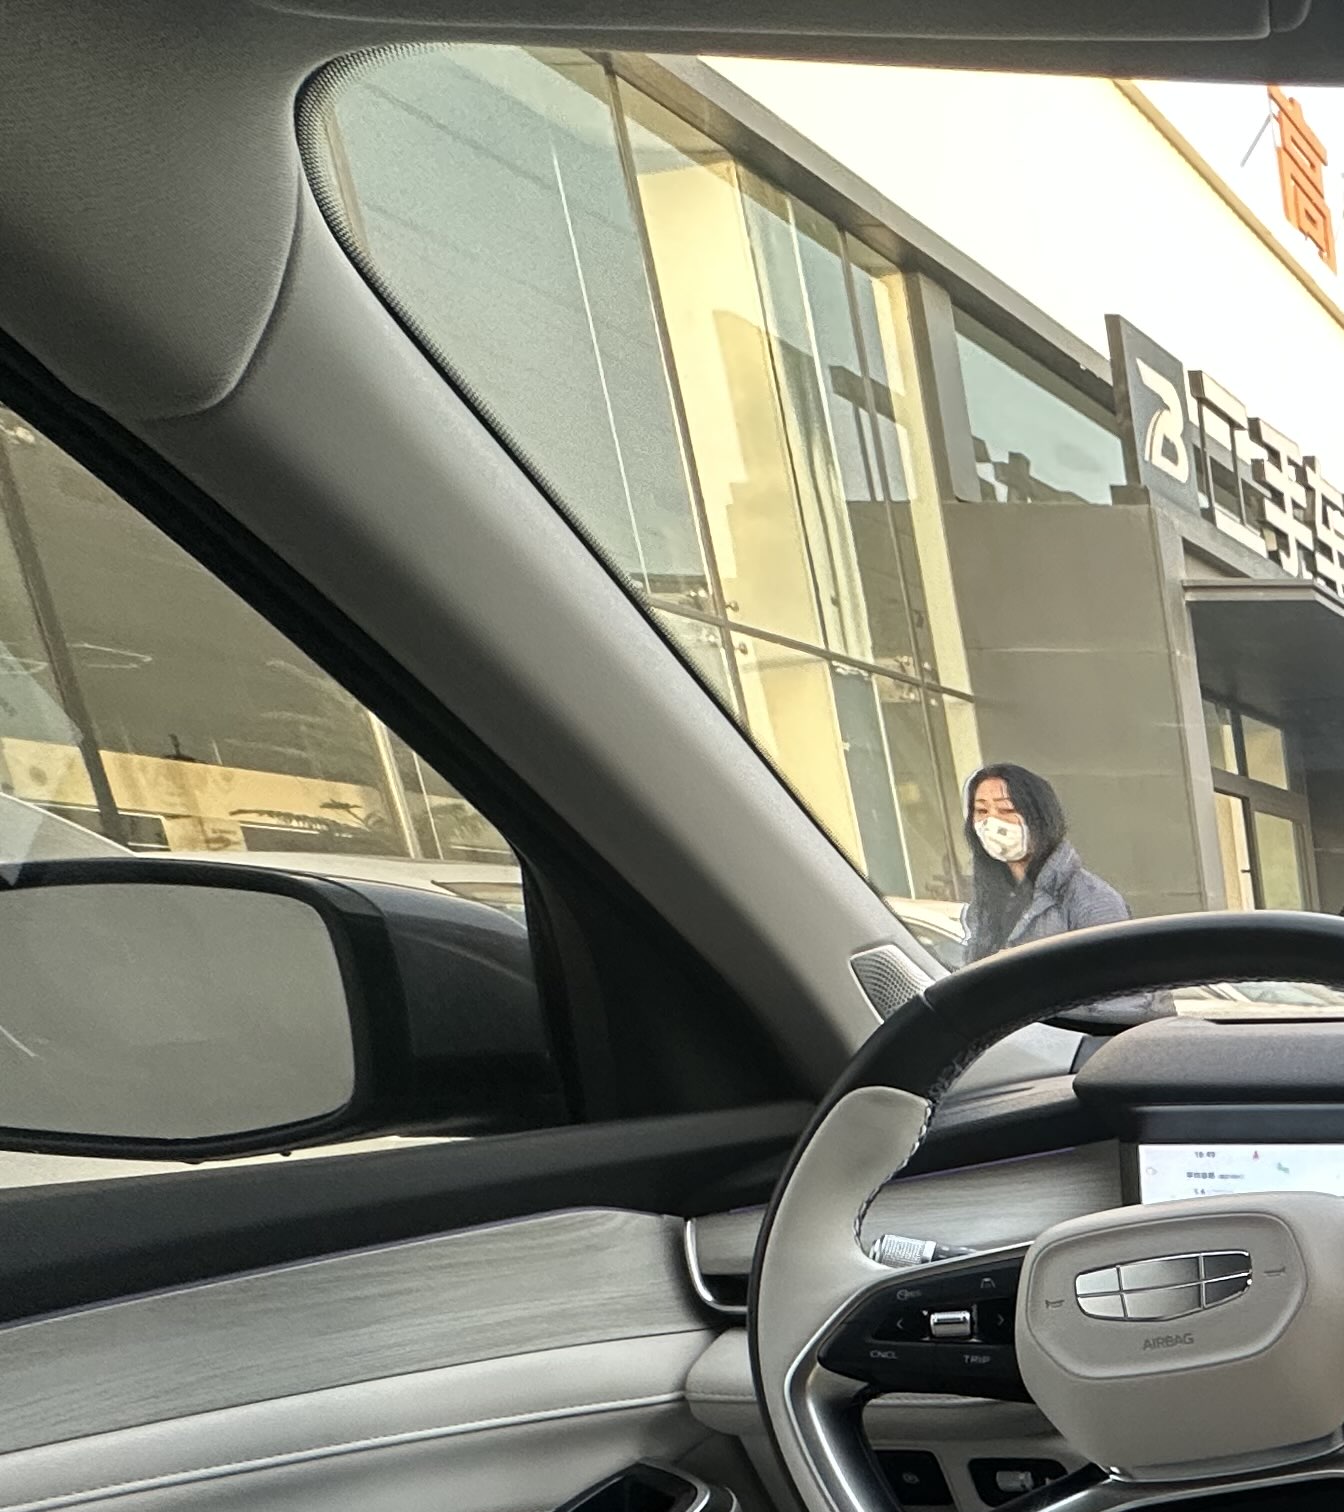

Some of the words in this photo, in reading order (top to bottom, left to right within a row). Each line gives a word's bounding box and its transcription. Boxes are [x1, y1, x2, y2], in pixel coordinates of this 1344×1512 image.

[1143, 1333, 1194, 1351] AIRBAG
[870, 1351, 897, 1359] CNCL
[963, 1355, 991, 1364] TRIP
